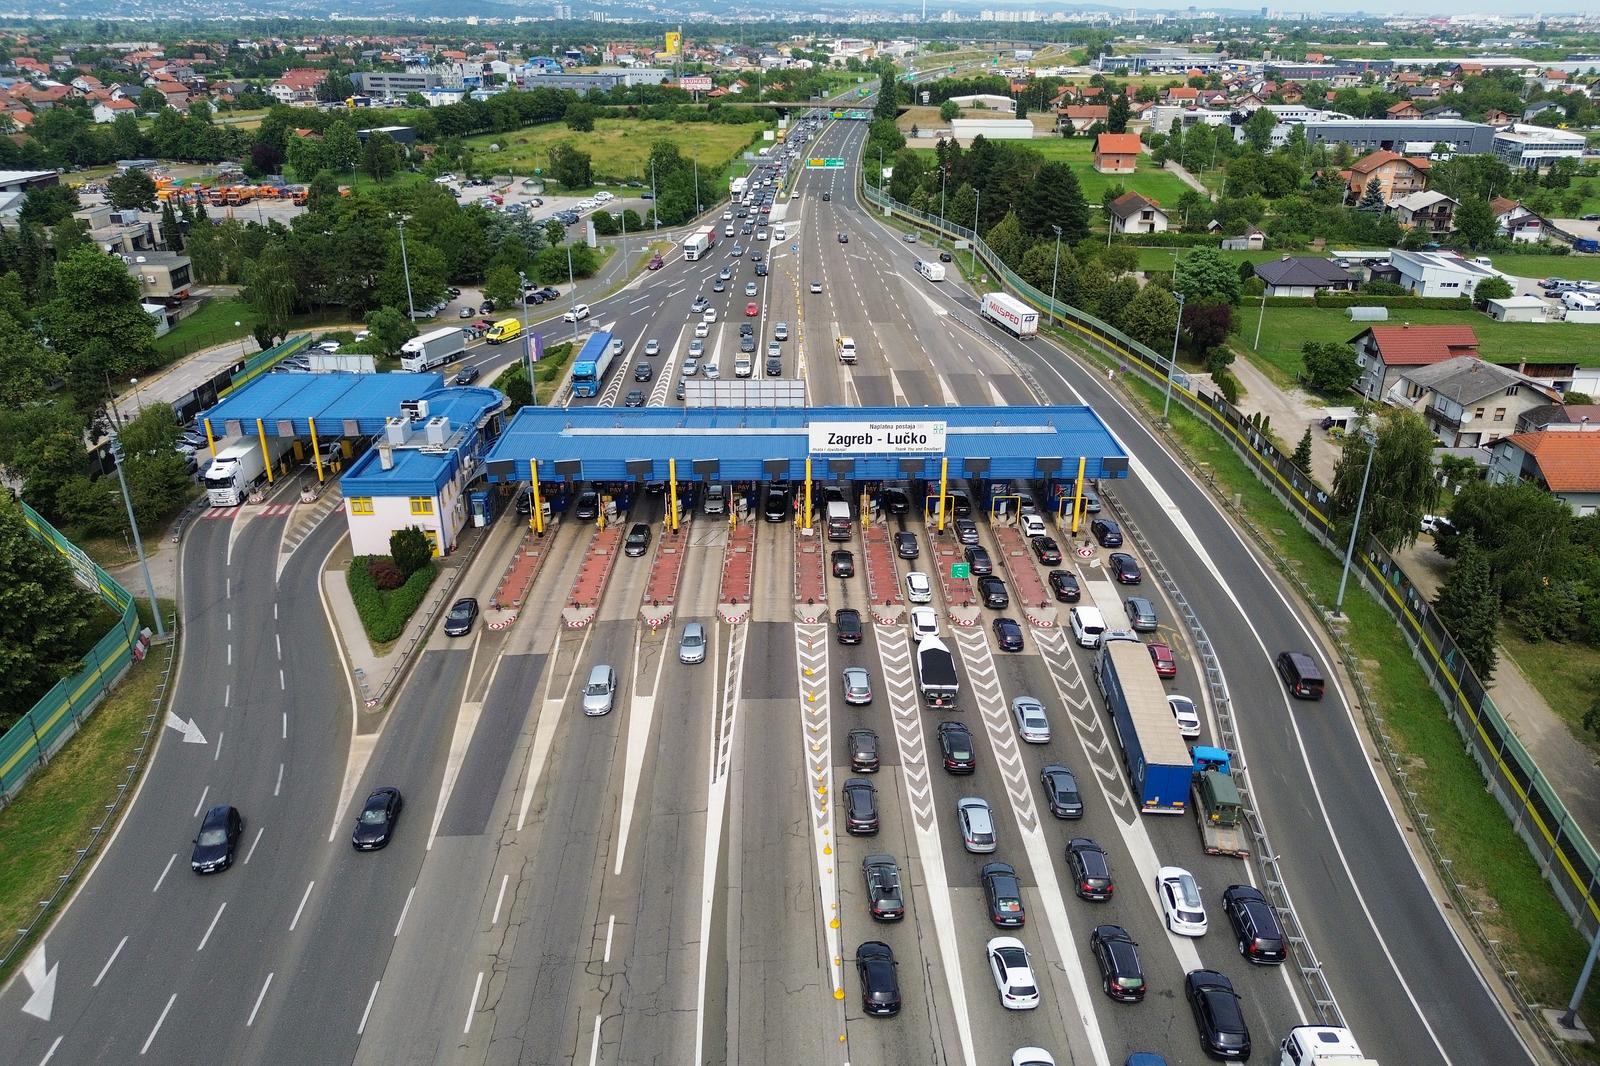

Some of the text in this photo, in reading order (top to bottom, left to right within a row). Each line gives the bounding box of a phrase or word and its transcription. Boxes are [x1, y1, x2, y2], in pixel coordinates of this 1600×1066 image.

[989, 301, 1020, 325] MILSPED
[895, 423, 916, 431] postaja
[827, 432, 873, 448] Zagreb
[887, 431, 927, 445] Lučko
